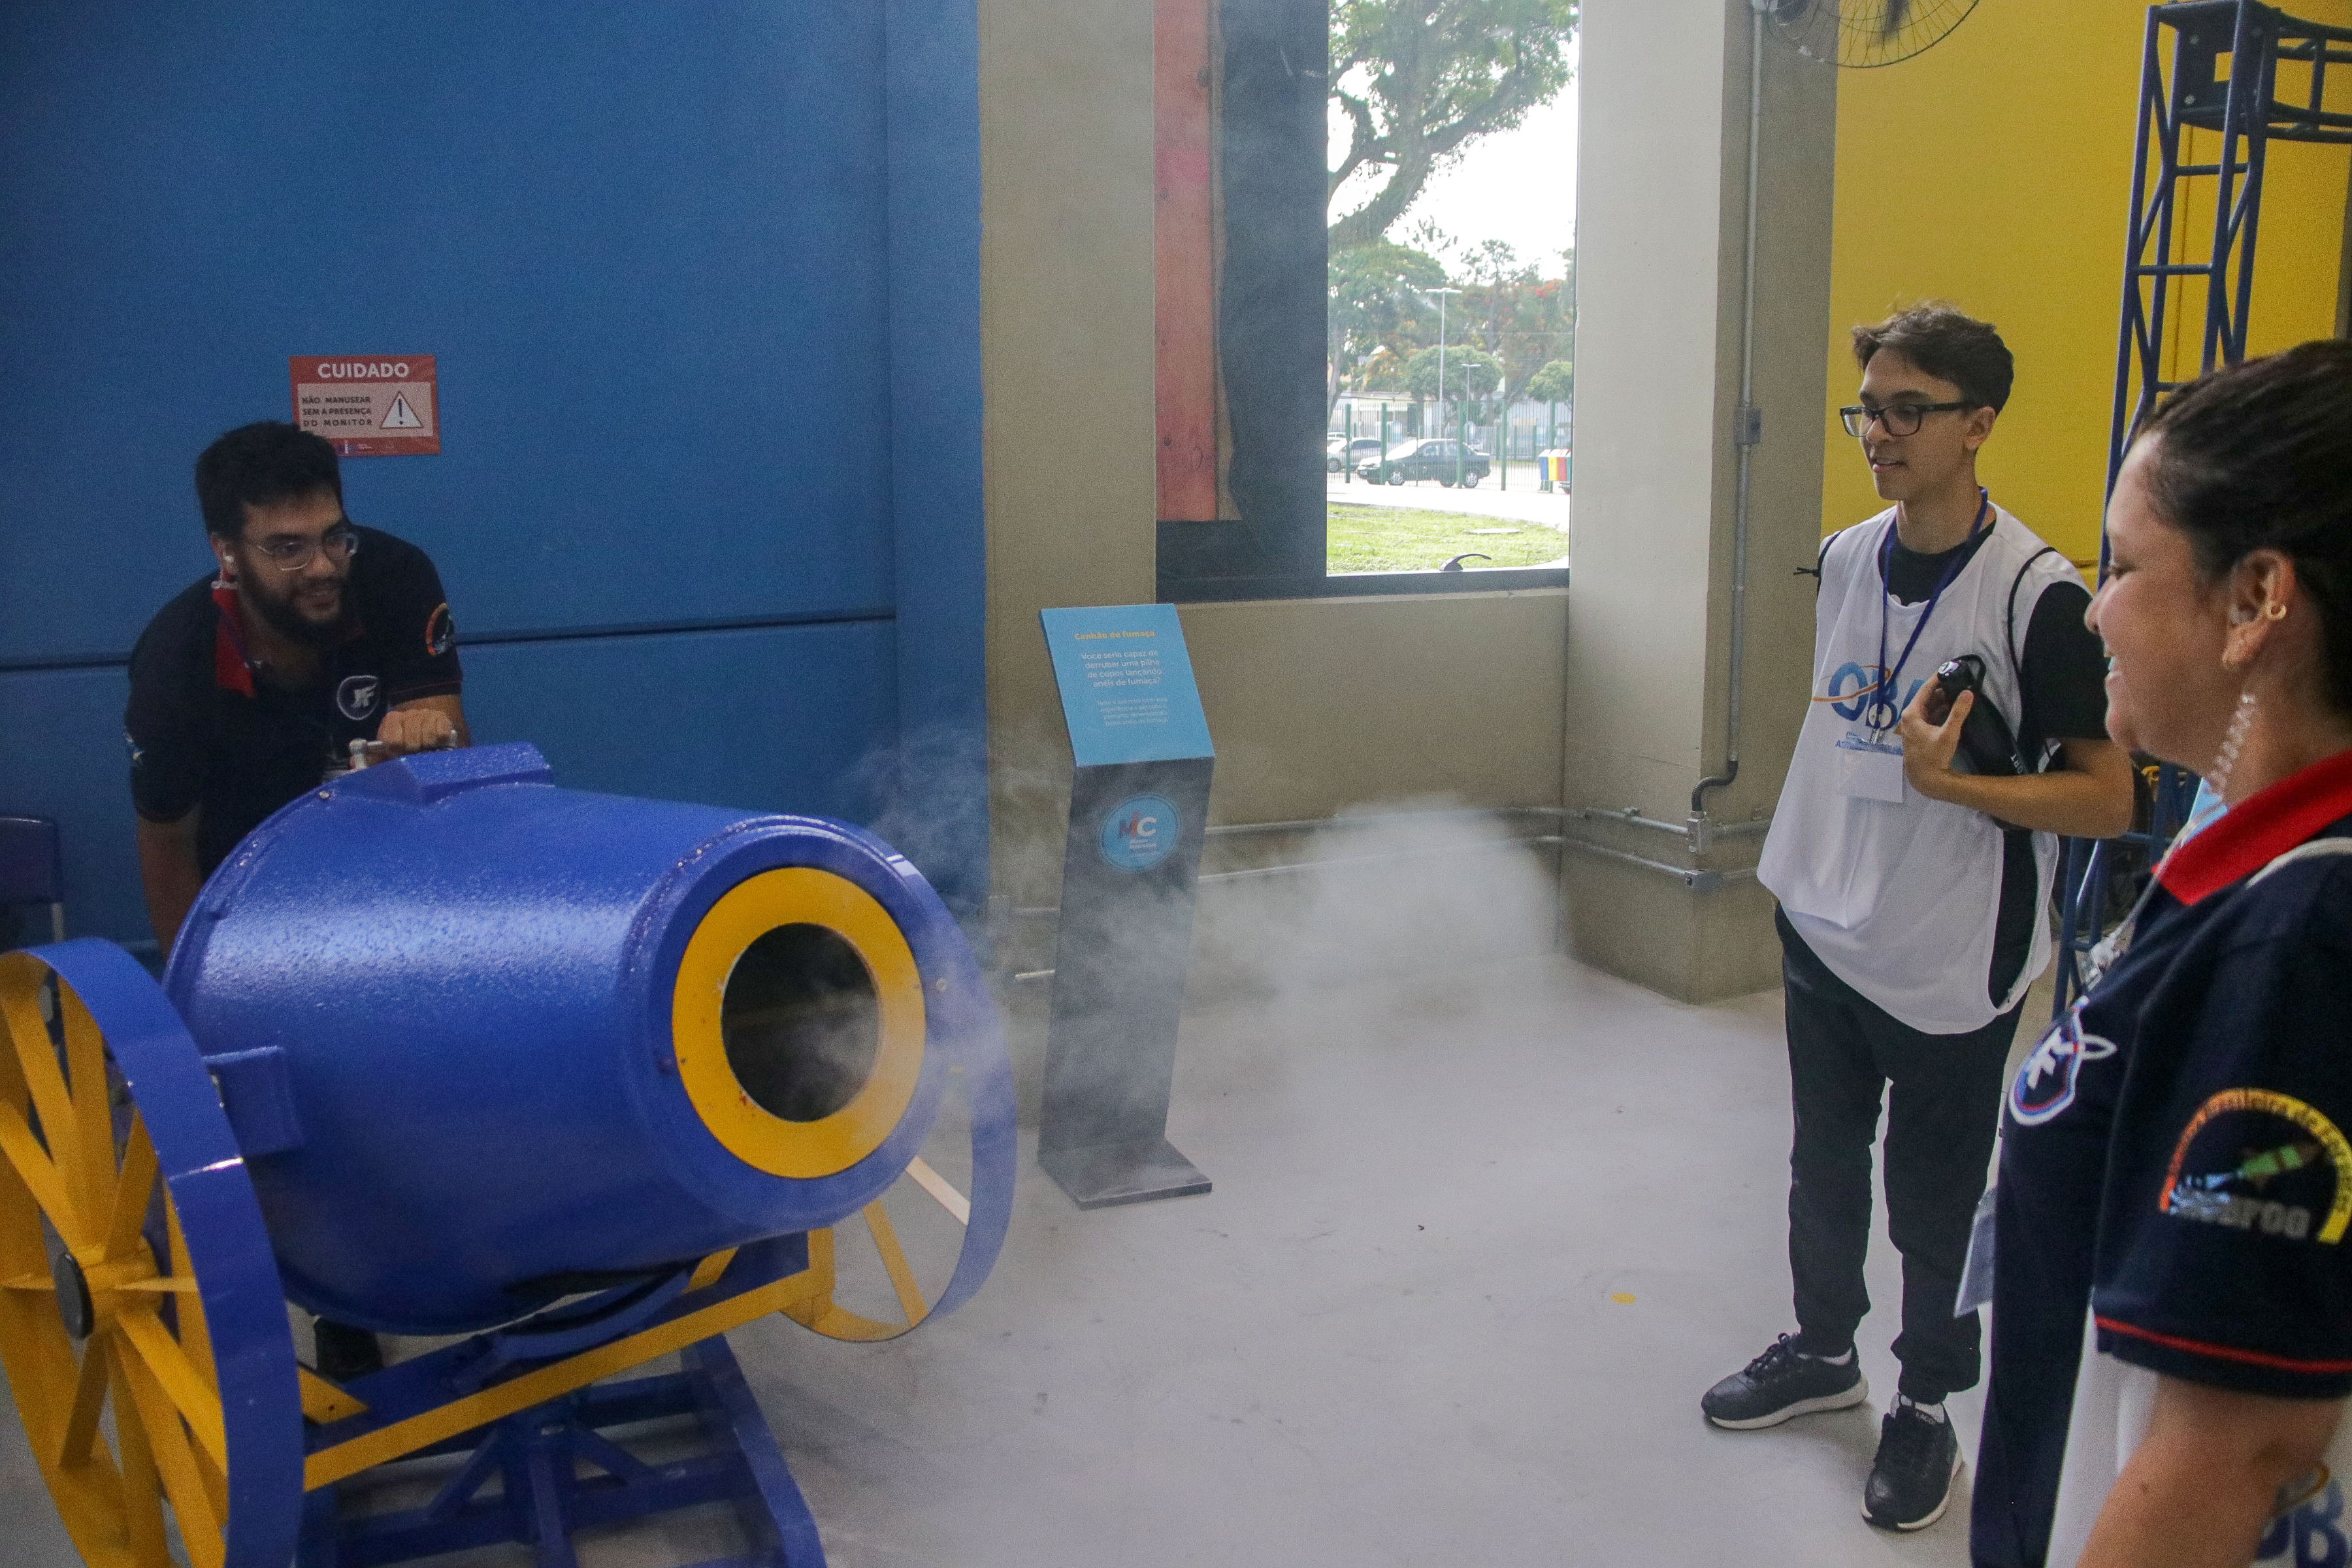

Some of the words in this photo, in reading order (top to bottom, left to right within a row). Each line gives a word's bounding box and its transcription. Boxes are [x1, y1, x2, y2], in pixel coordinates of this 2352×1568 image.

[318, 363, 410, 378] CUIDADO
[302, 396, 320, 404] NÃO
[1128, 677, 1160, 685] fumaça?
